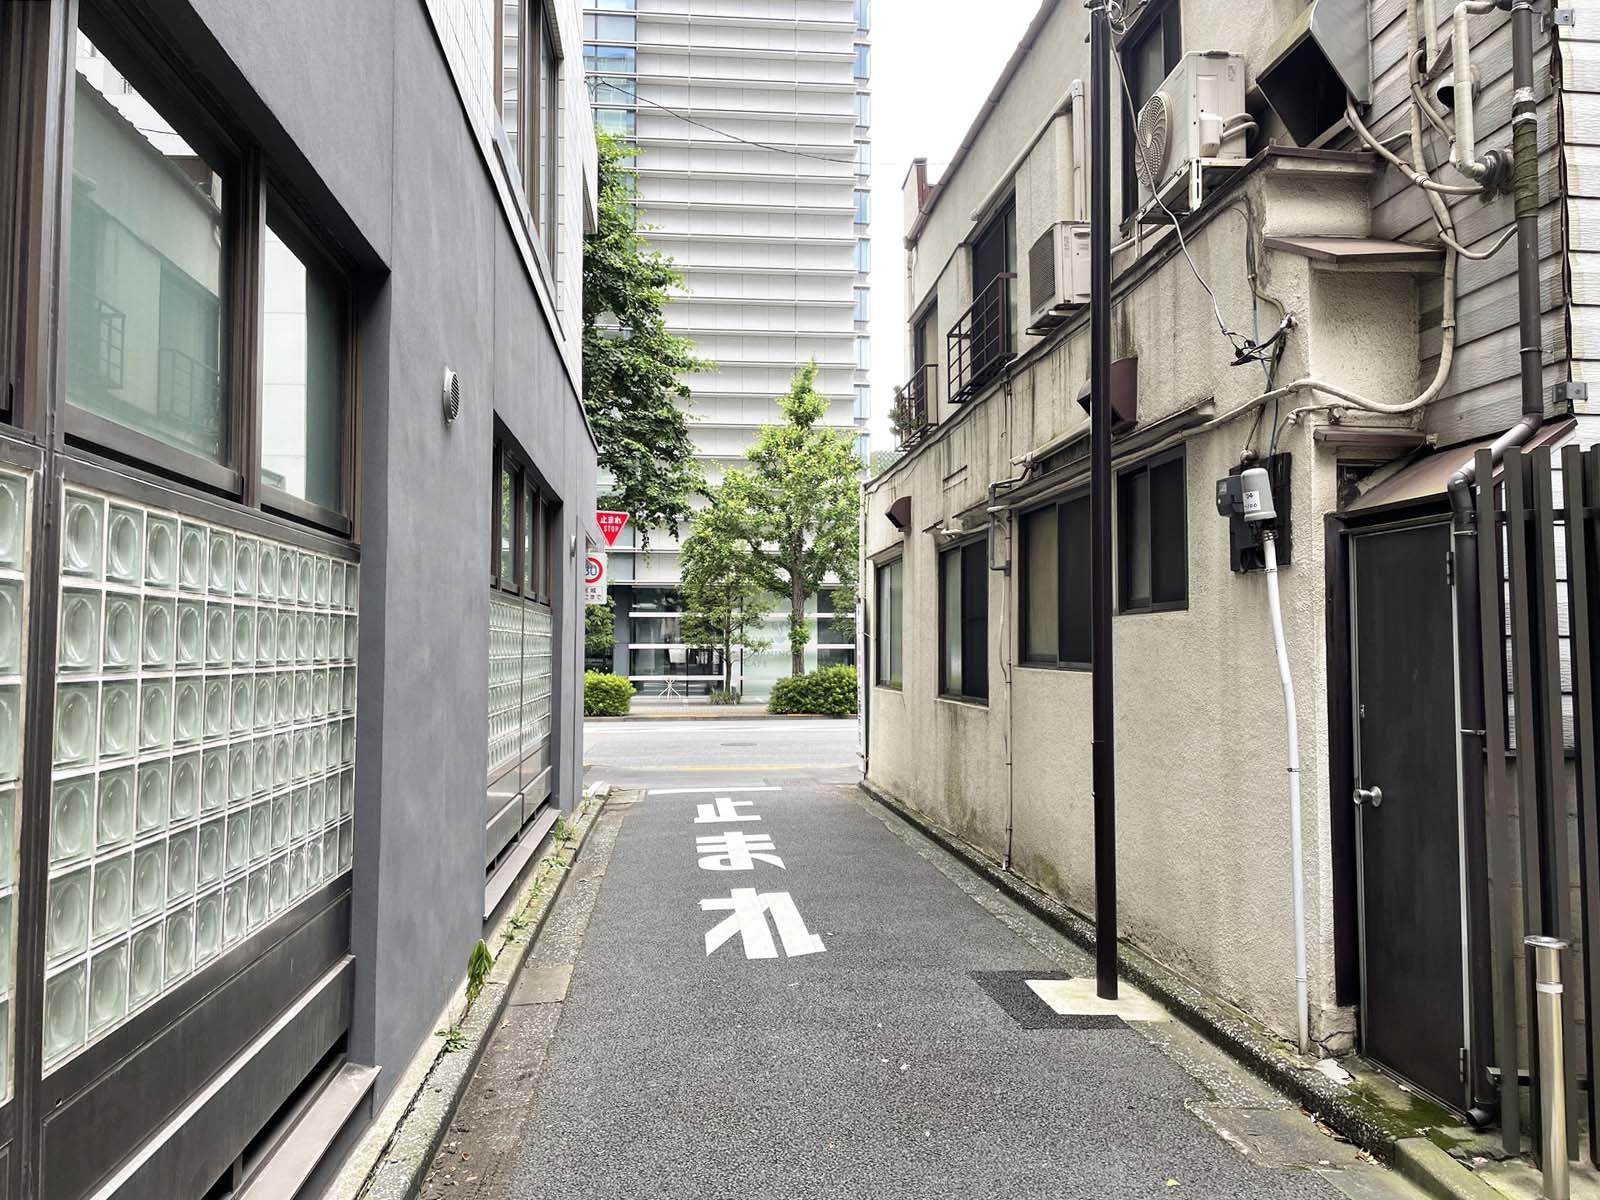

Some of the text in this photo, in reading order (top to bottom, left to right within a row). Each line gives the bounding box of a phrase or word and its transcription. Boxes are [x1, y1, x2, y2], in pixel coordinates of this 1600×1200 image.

[600, 516, 622, 524] 止まれ
[603, 525, 619, 533] STOP
[693, 797, 827, 960] 止まれ
